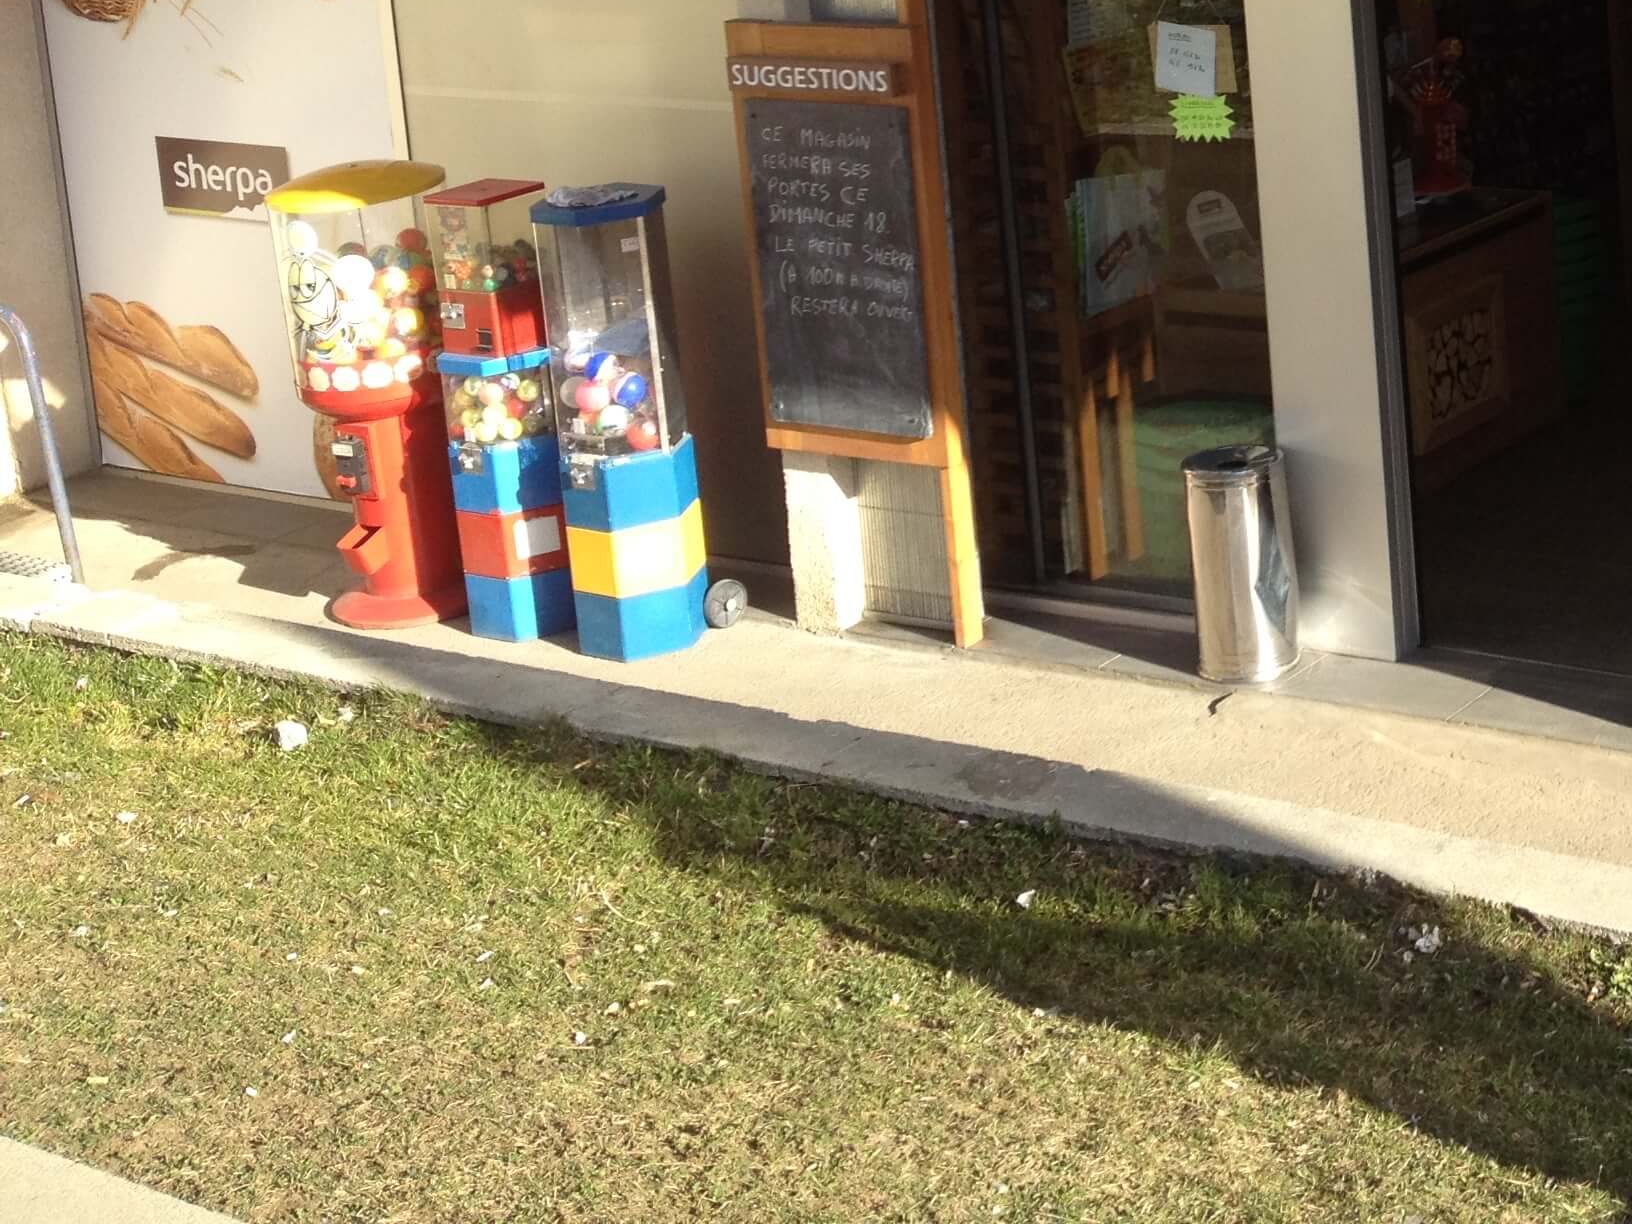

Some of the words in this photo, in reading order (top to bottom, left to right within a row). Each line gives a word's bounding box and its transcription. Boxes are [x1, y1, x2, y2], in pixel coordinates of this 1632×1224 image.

[731, 64, 888, 92] SUGGESTIONS
[761, 126, 784, 142] CE
[173, 153, 273, 201] sherpa
[838, 160, 872, 180] SES
[767, 176, 831, 202] PORTES
[840, 186, 870, 205] CE
[776, 236, 795, 252] LE
